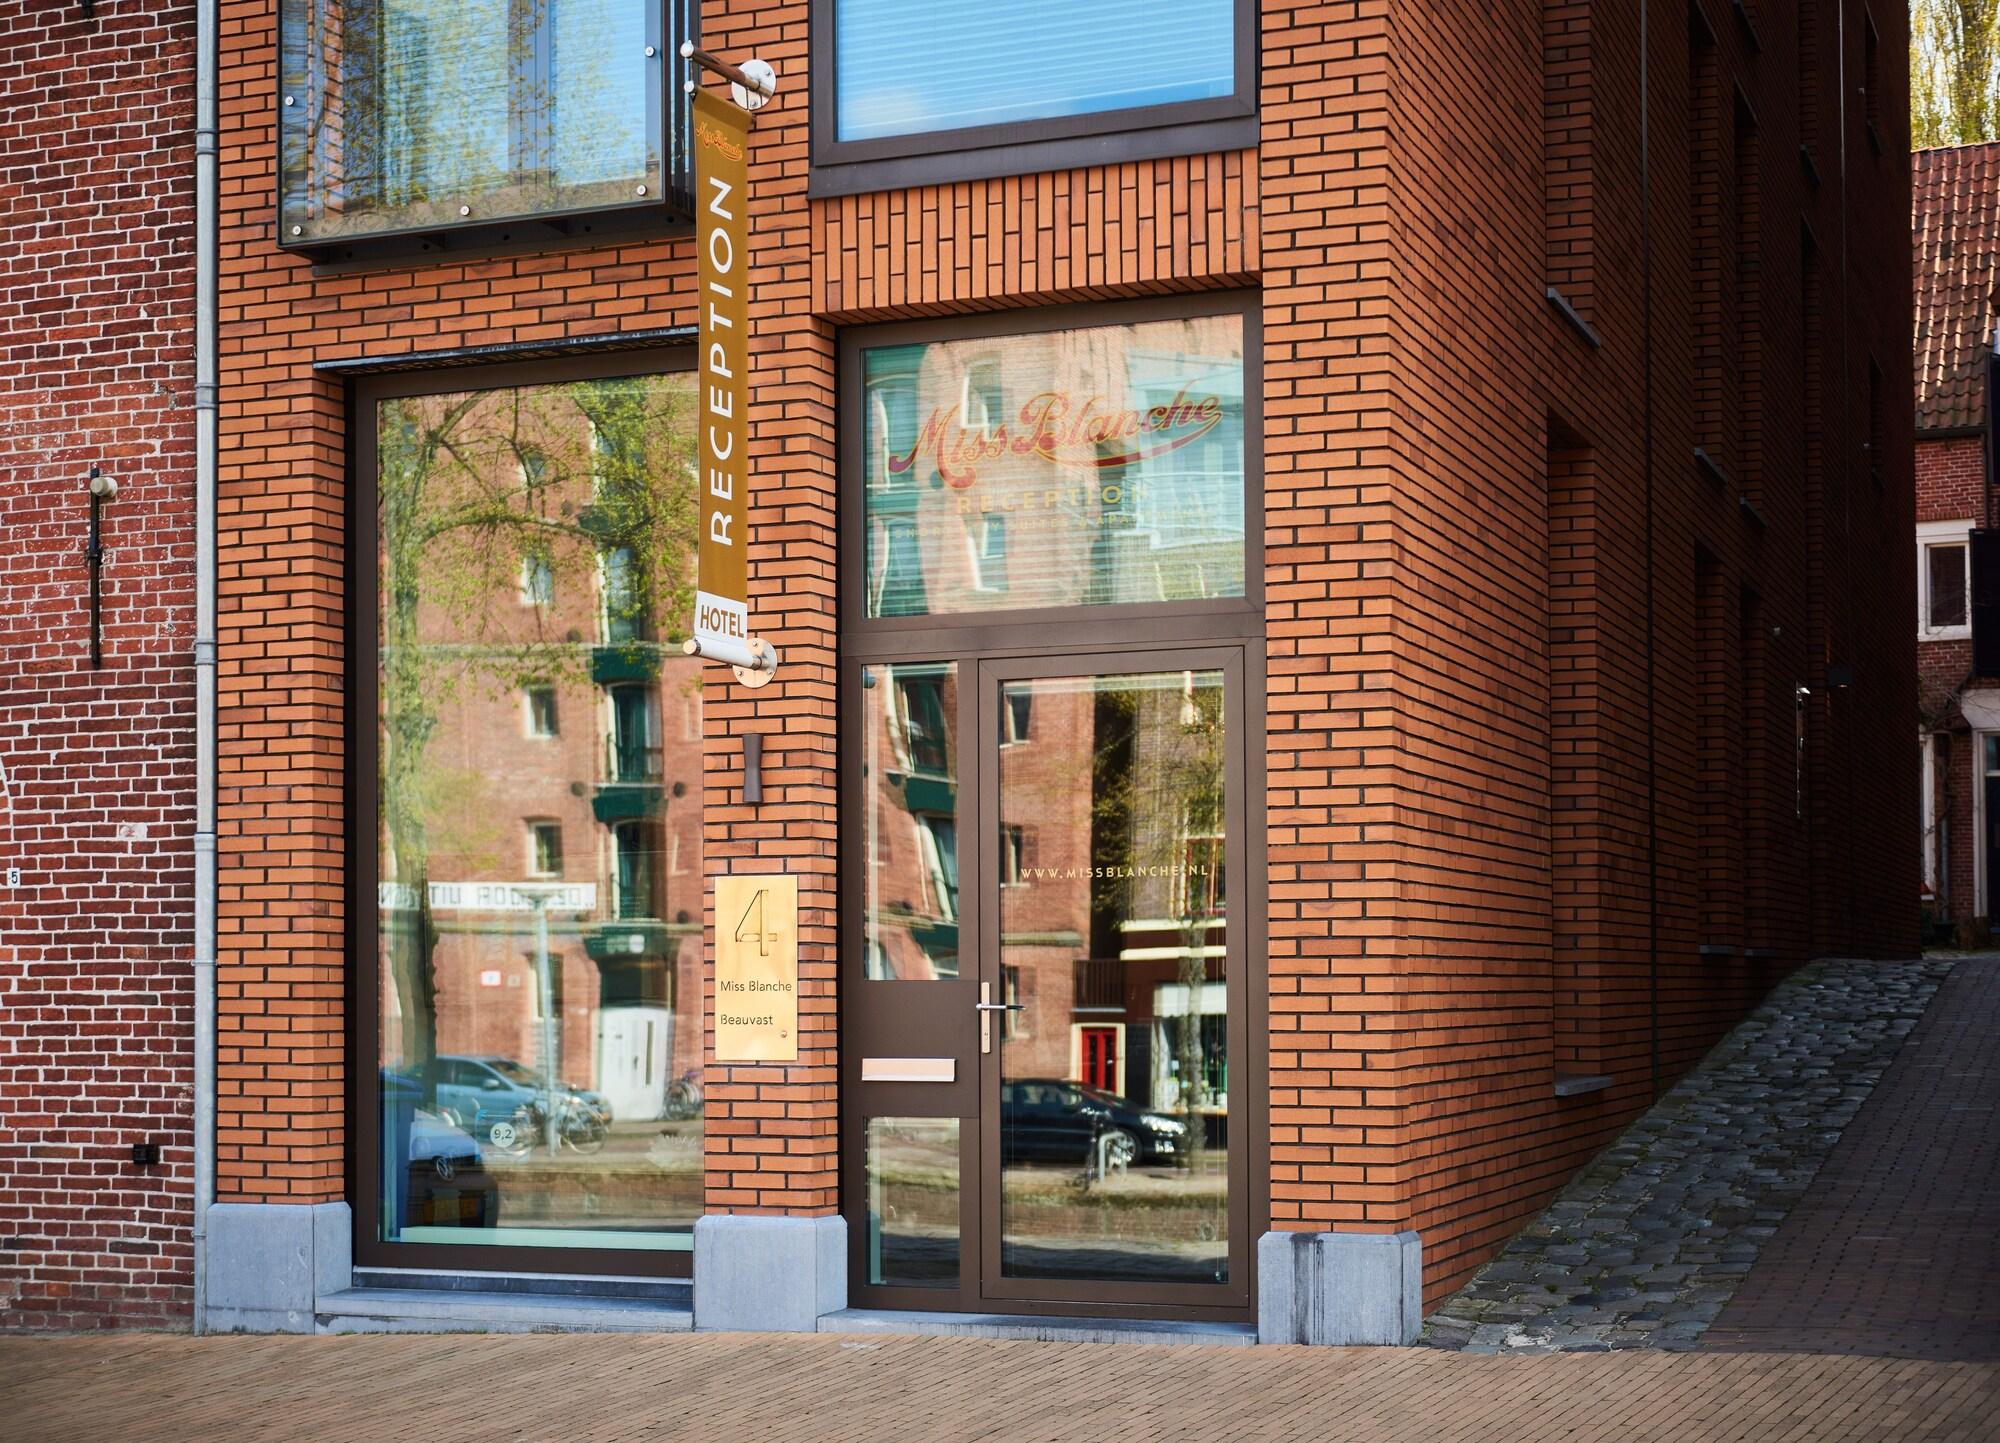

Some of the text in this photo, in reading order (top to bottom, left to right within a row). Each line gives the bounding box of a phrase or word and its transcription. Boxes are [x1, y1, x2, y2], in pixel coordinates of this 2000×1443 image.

[709, 176, 734, 547] RECEPTION
[889, 378, 1223, 490] Miss Blanche
[957, 484, 1148, 514] RECEPTION
[700, 604, 744, 638] HOTEL
[11, 871, 18, 884] 5
[1021, 864, 1208, 880] WWW.MISSBLANCHE.NL
[735, 888, 777, 956] 4
[720, 980, 792, 992] Miss Blanche
[720, 1013, 773, 1025] Beauvast
[494, 1128, 513, 1141] 9,2
